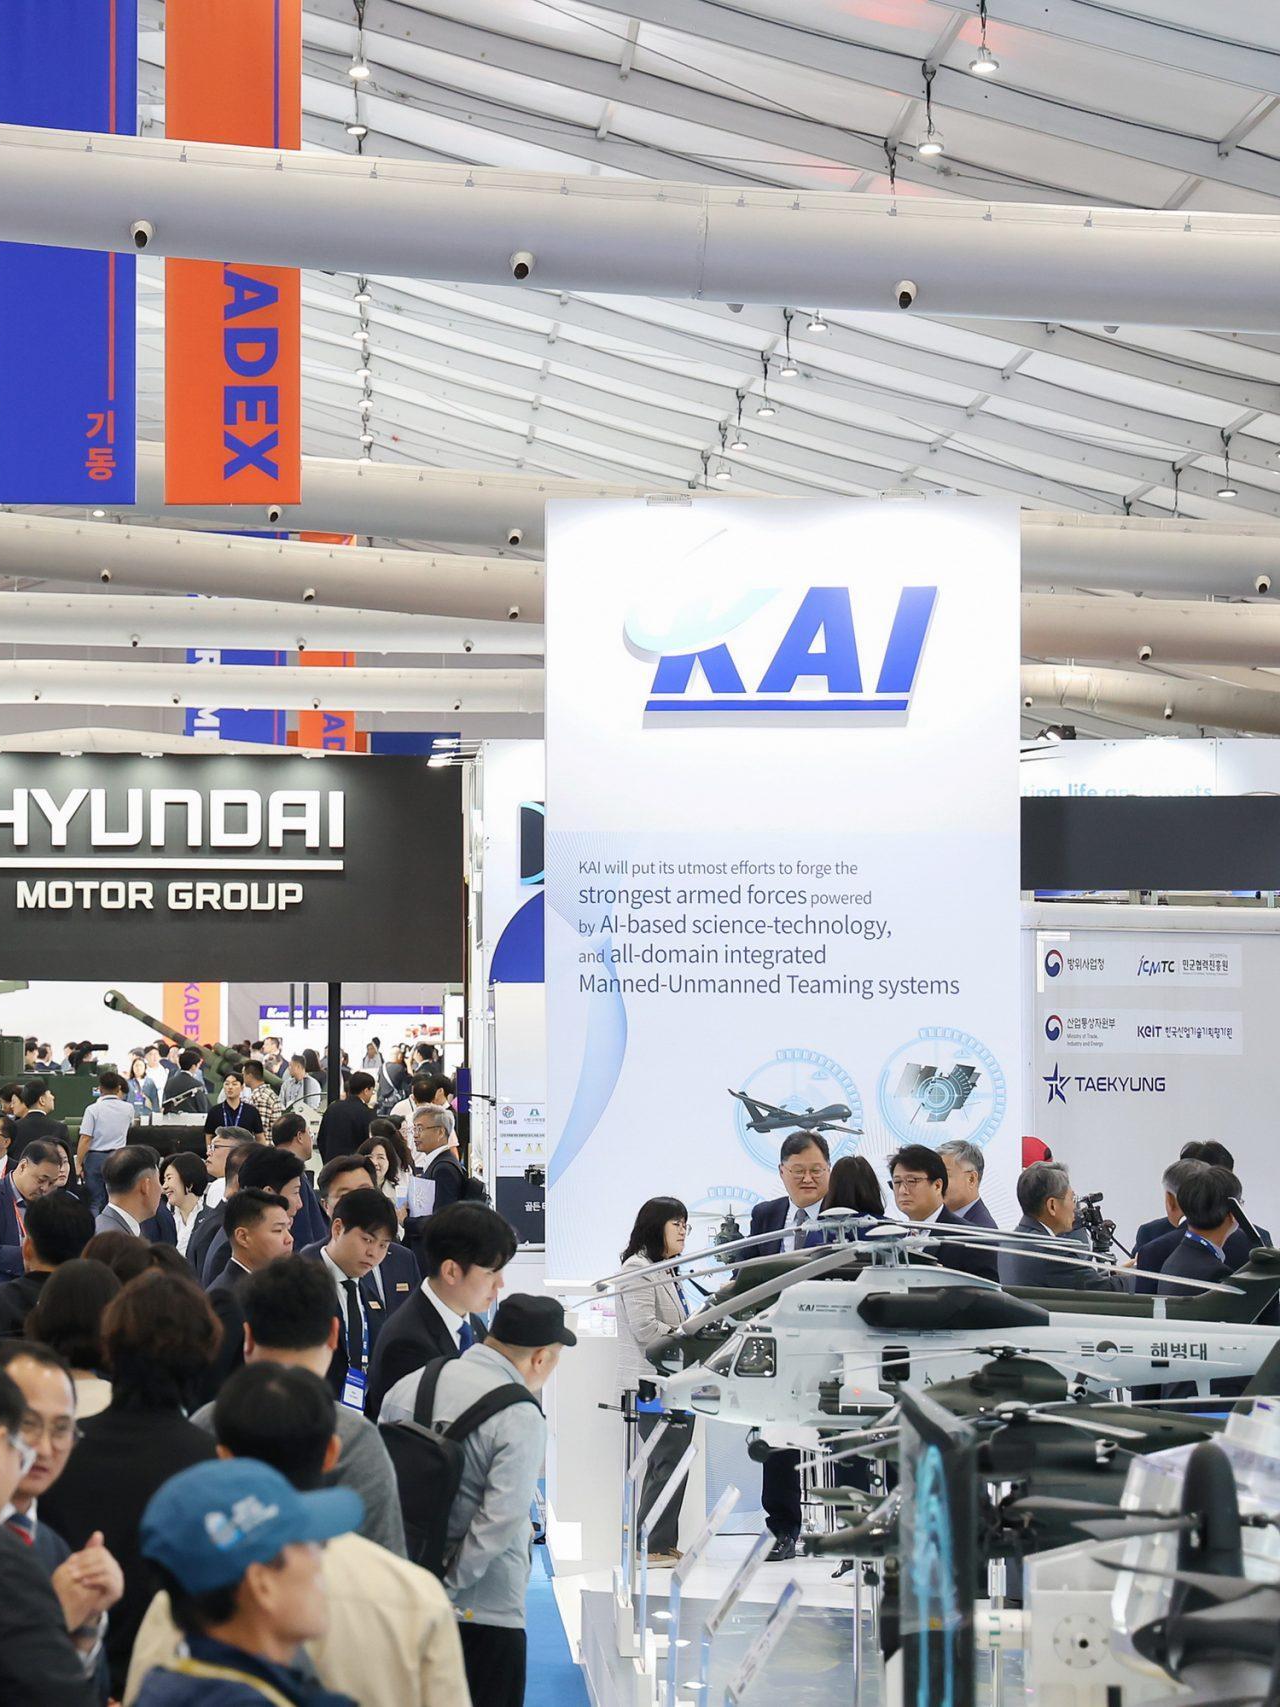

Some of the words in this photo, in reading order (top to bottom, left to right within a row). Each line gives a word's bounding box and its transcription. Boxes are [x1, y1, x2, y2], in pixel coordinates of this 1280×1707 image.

[223, 261, 279, 481] ADEX
[85, 410, 116, 482] 기동
[625, 585, 939, 695] KAI
[579, 861, 601, 876] KAI
[604, 860, 628, 876] will
[632, 862, 656, 880] put
[659, 861, 675, 876] its
[678, 862, 728, 876] utmost
[731, 860, 776, 876] efforts
[778, 862, 793, 876] to
[796, 860, 832, 880] forge
[835, 861, 858, 876] the
[16, 881, 154, 909] MOTOR
[168, 882, 303, 911] GROUP
[579, 885, 671, 909] strongest
[676, 885, 742, 905] armed
[747, 885, 807, 905] forces
[811, 891, 872, 909] powered
[578, 919, 596, 938] by
[600, 915, 687, 936] AI-based
[692, 915, 892, 940] science-technology,
[578, 949, 605, 965] and
[610, 944, 719, 966] all-domain
[724, 945, 826, 970] integrated
[1067, 958, 1105, 971] 방위사업청
[1182, 959, 1229, 972] 민군협력진흥원
[579, 974, 781, 996] Manned-Unmanned
[786, 975, 874, 1001] Teaming
[878, 977, 960, 1000] systems
[1067, 1017, 1116, 1030] 산업통상자원부
[1165, 1026, 1232, 1040] 한국산업기술기획평가원
[1074, 1076, 1166, 1093] TAEKYUNG
[1150, 1342, 1207, 1361] 해병대
